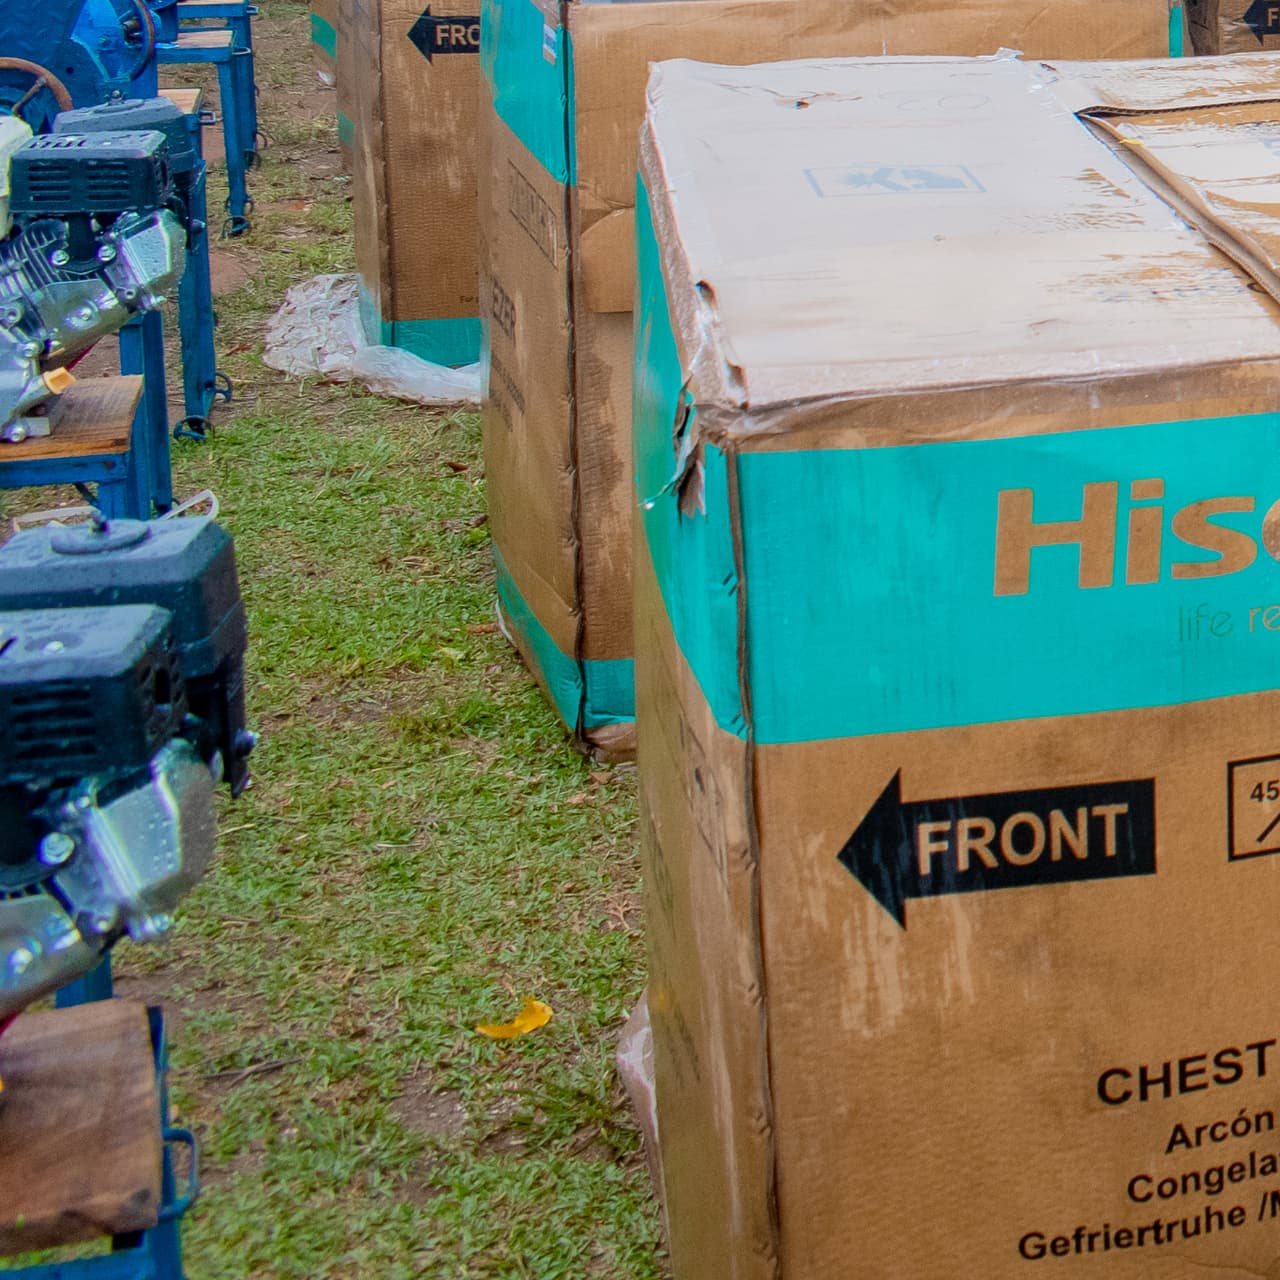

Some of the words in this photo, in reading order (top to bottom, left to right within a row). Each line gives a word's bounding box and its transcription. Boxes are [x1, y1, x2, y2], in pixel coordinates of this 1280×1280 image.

[435, 23, 480, 47] FRO
[1178, 603, 1234, 643] life
[916, 803, 1128, 882] FRONT
[1096, 1038, 1277, 1107] CHEST
[1164, 1105, 1275, 1154] Arcón
[1017, 1199, 1247, 1261] Gefriertruhe
